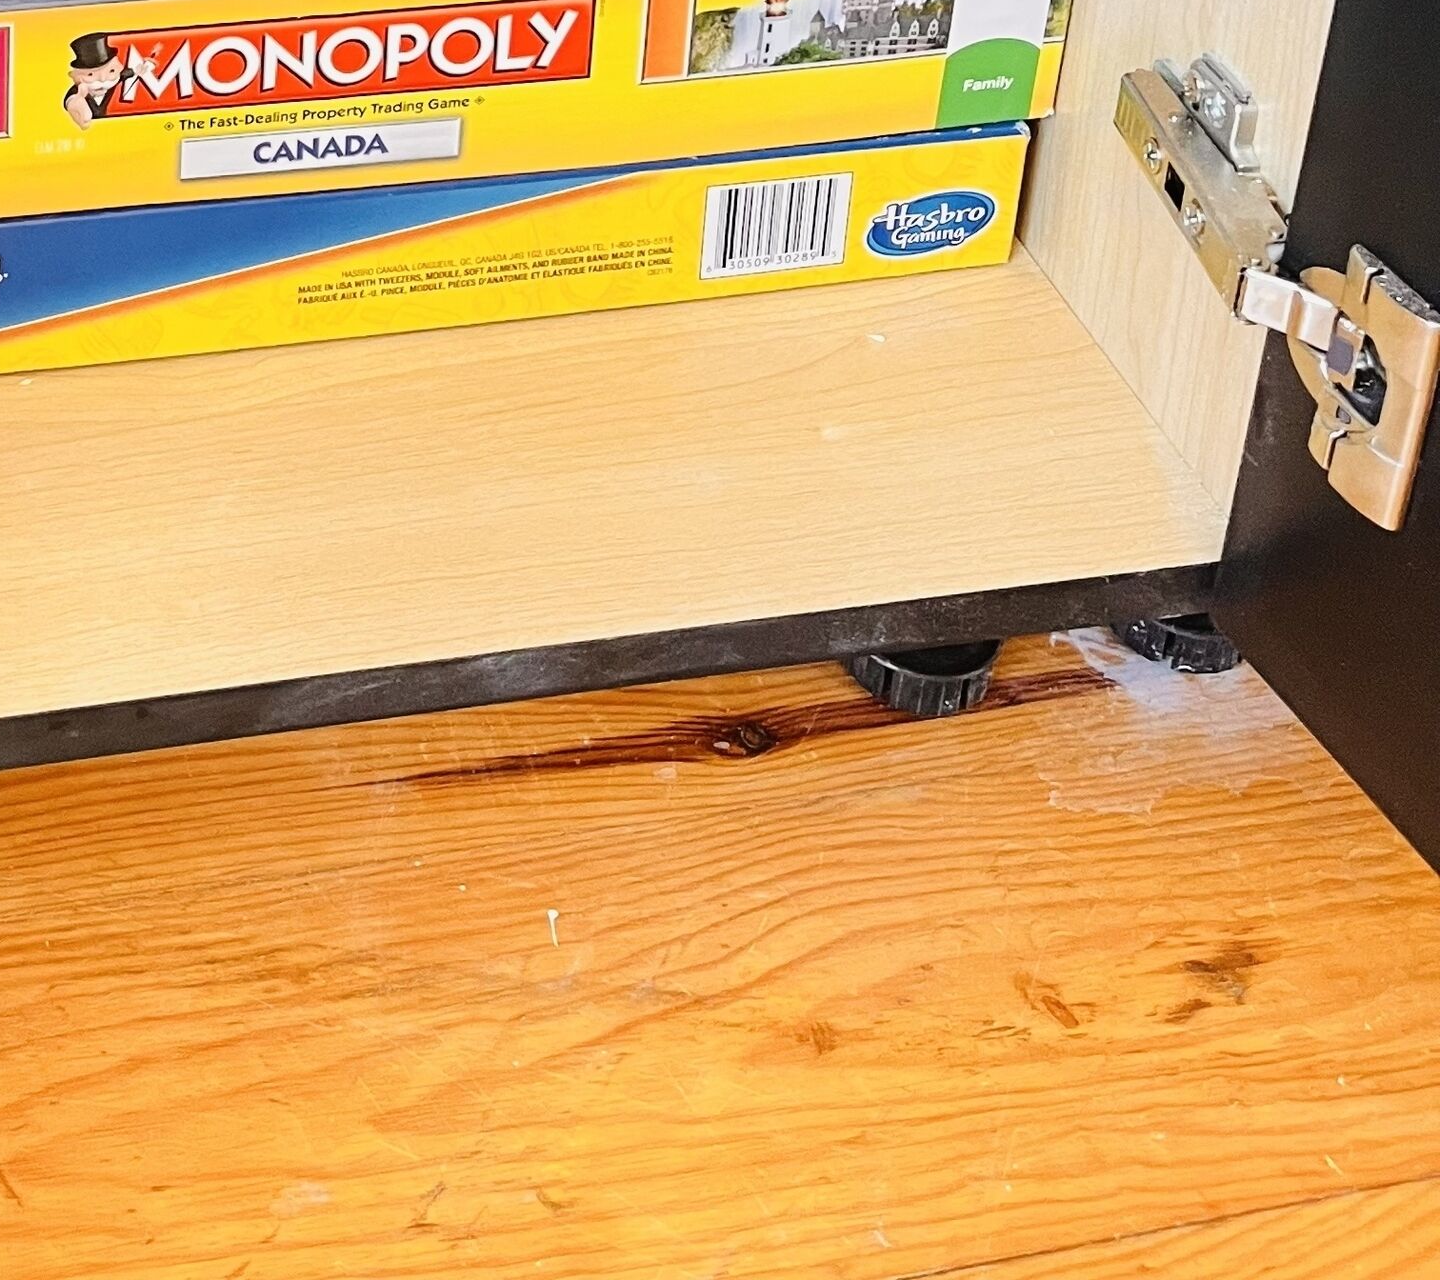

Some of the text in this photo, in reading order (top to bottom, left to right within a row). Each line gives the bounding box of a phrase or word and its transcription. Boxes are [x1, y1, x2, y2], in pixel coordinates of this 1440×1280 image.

[120, 6, 580, 102] MONOPOLY
[962, 75, 1015, 93] Family
[179, 96, 470, 131] The Fast-Dealing Property Trading Game
[253, 133, 389, 165] CANADA
[874, 202, 987, 230] Hasbro
[890, 226, 966, 252] Gaming
[298, 284, 322, 294] MADE
[355, 278, 376, 288] WITH
[464, 266, 484, 277] SOFT
[532, 259, 550, 269] AND
[611, 250, 635, 260] MADE
[729, 251, 817, 271] 30509 30289
